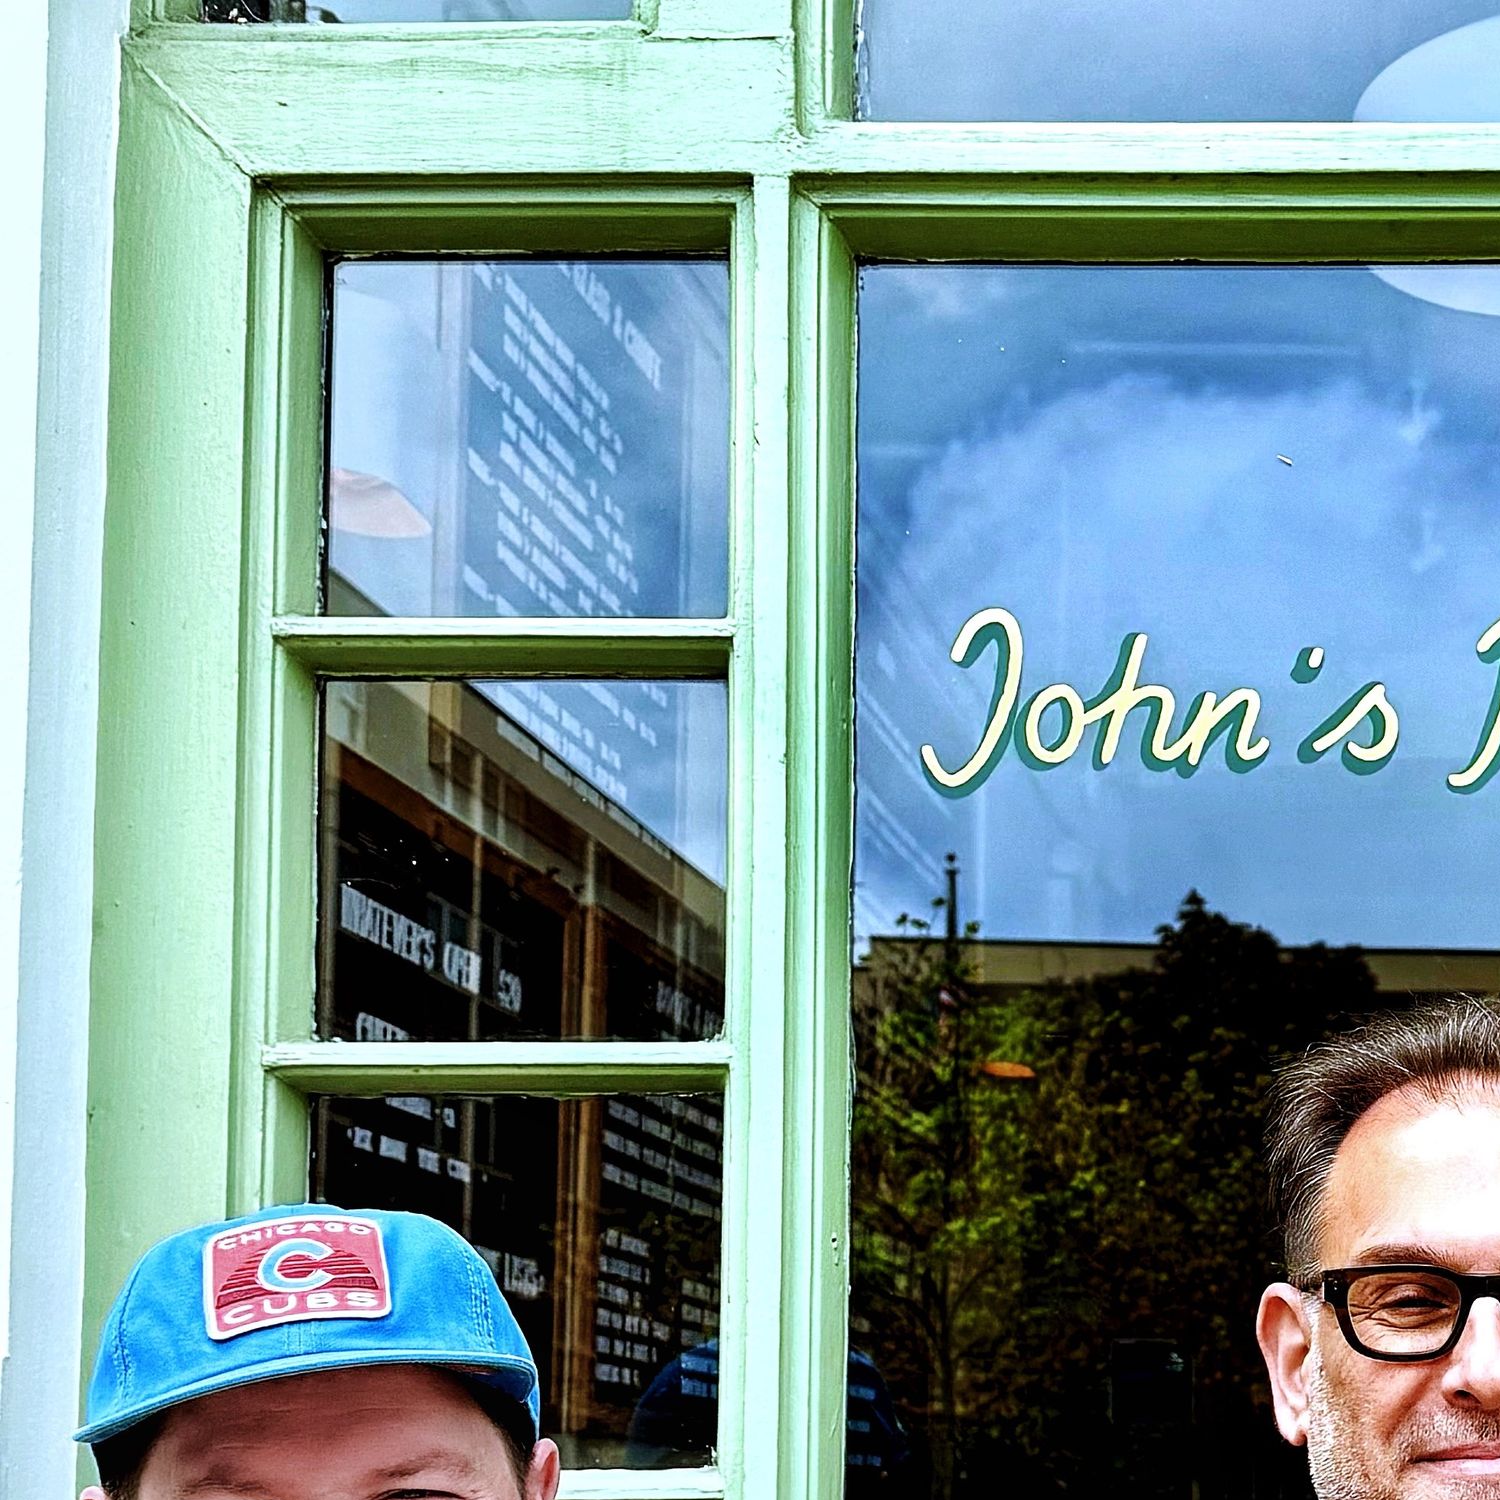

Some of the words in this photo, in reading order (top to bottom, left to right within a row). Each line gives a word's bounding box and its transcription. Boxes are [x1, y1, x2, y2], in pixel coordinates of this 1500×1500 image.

[921, 606, 1400, 797] John's
[217, 1220, 372, 1251] CHICAGO
[222, 1291, 379, 1325] CUBS
